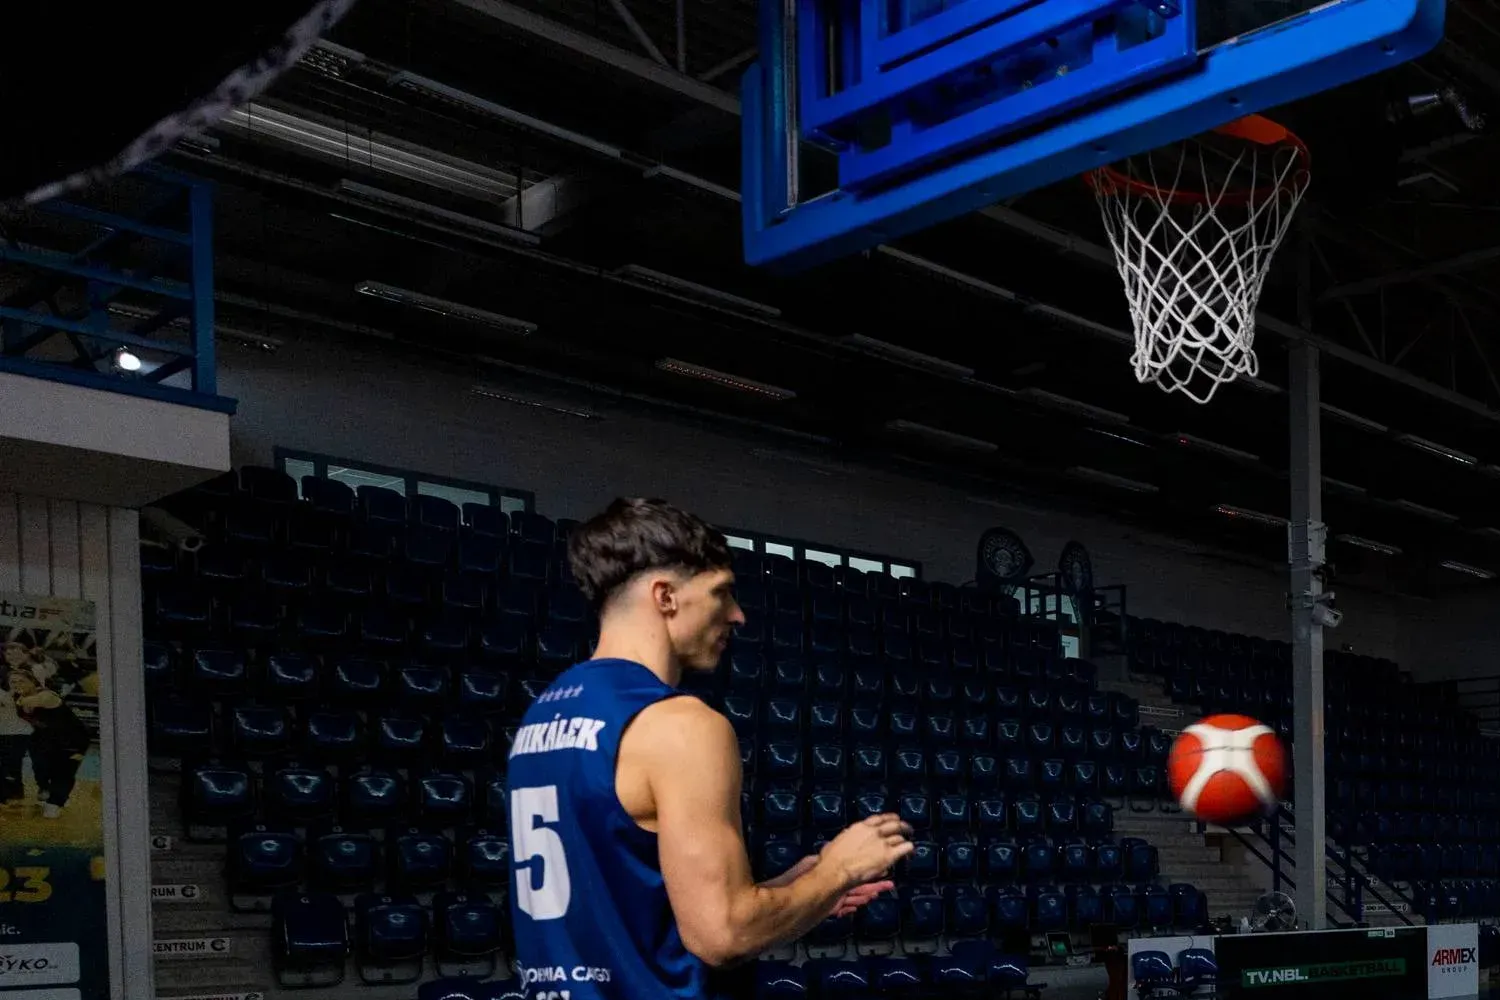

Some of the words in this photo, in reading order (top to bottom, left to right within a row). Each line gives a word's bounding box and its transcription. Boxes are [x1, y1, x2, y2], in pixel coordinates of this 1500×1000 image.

[511, 784, 572, 921] 5
[0, 958, 48, 970] YKO
[1432, 948, 1476, 966] ARMEX
[1441, 965, 1468, 974] GROUP
